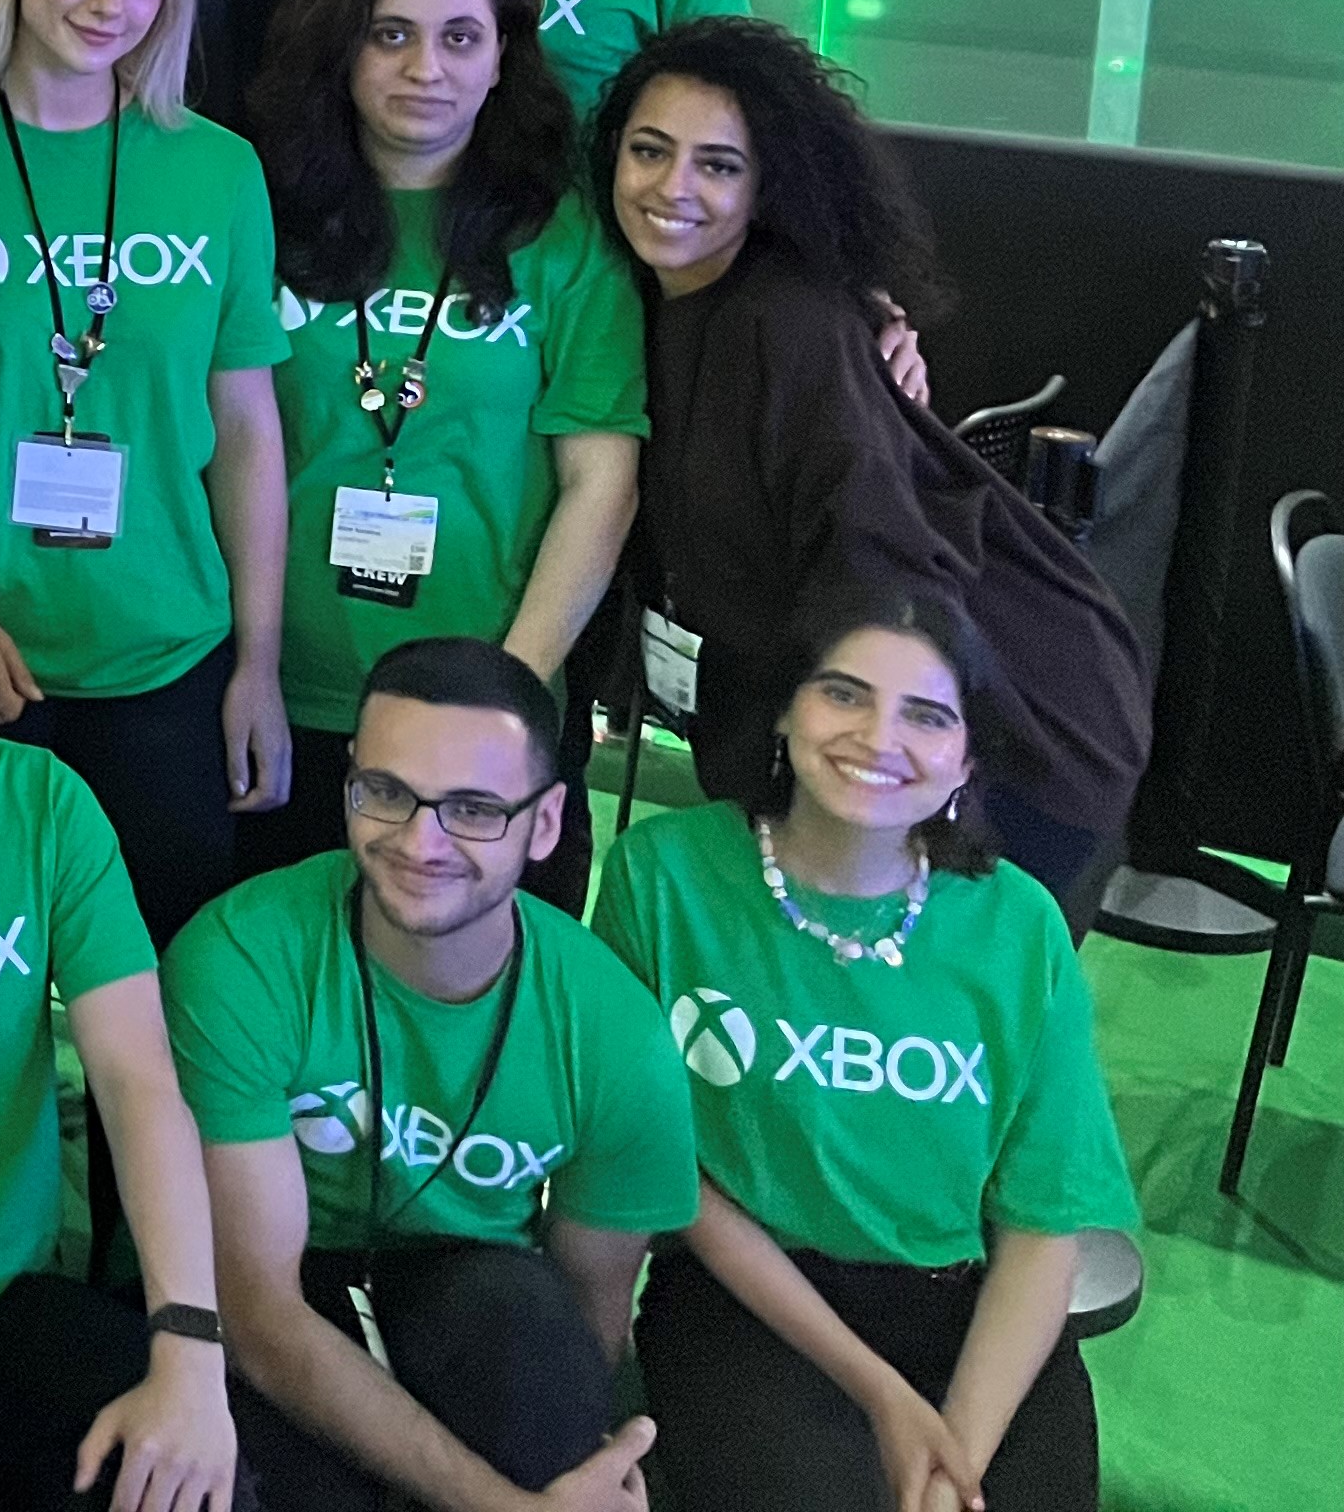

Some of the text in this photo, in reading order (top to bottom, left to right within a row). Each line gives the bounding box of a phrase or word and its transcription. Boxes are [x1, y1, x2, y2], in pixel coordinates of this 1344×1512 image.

[23, 233, 213, 287] XBOX
[351, 568, 409, 586] CREW
[774, 1018, 990, 1105] XBOX
[380, 1104, 564, 1189] XBOX
